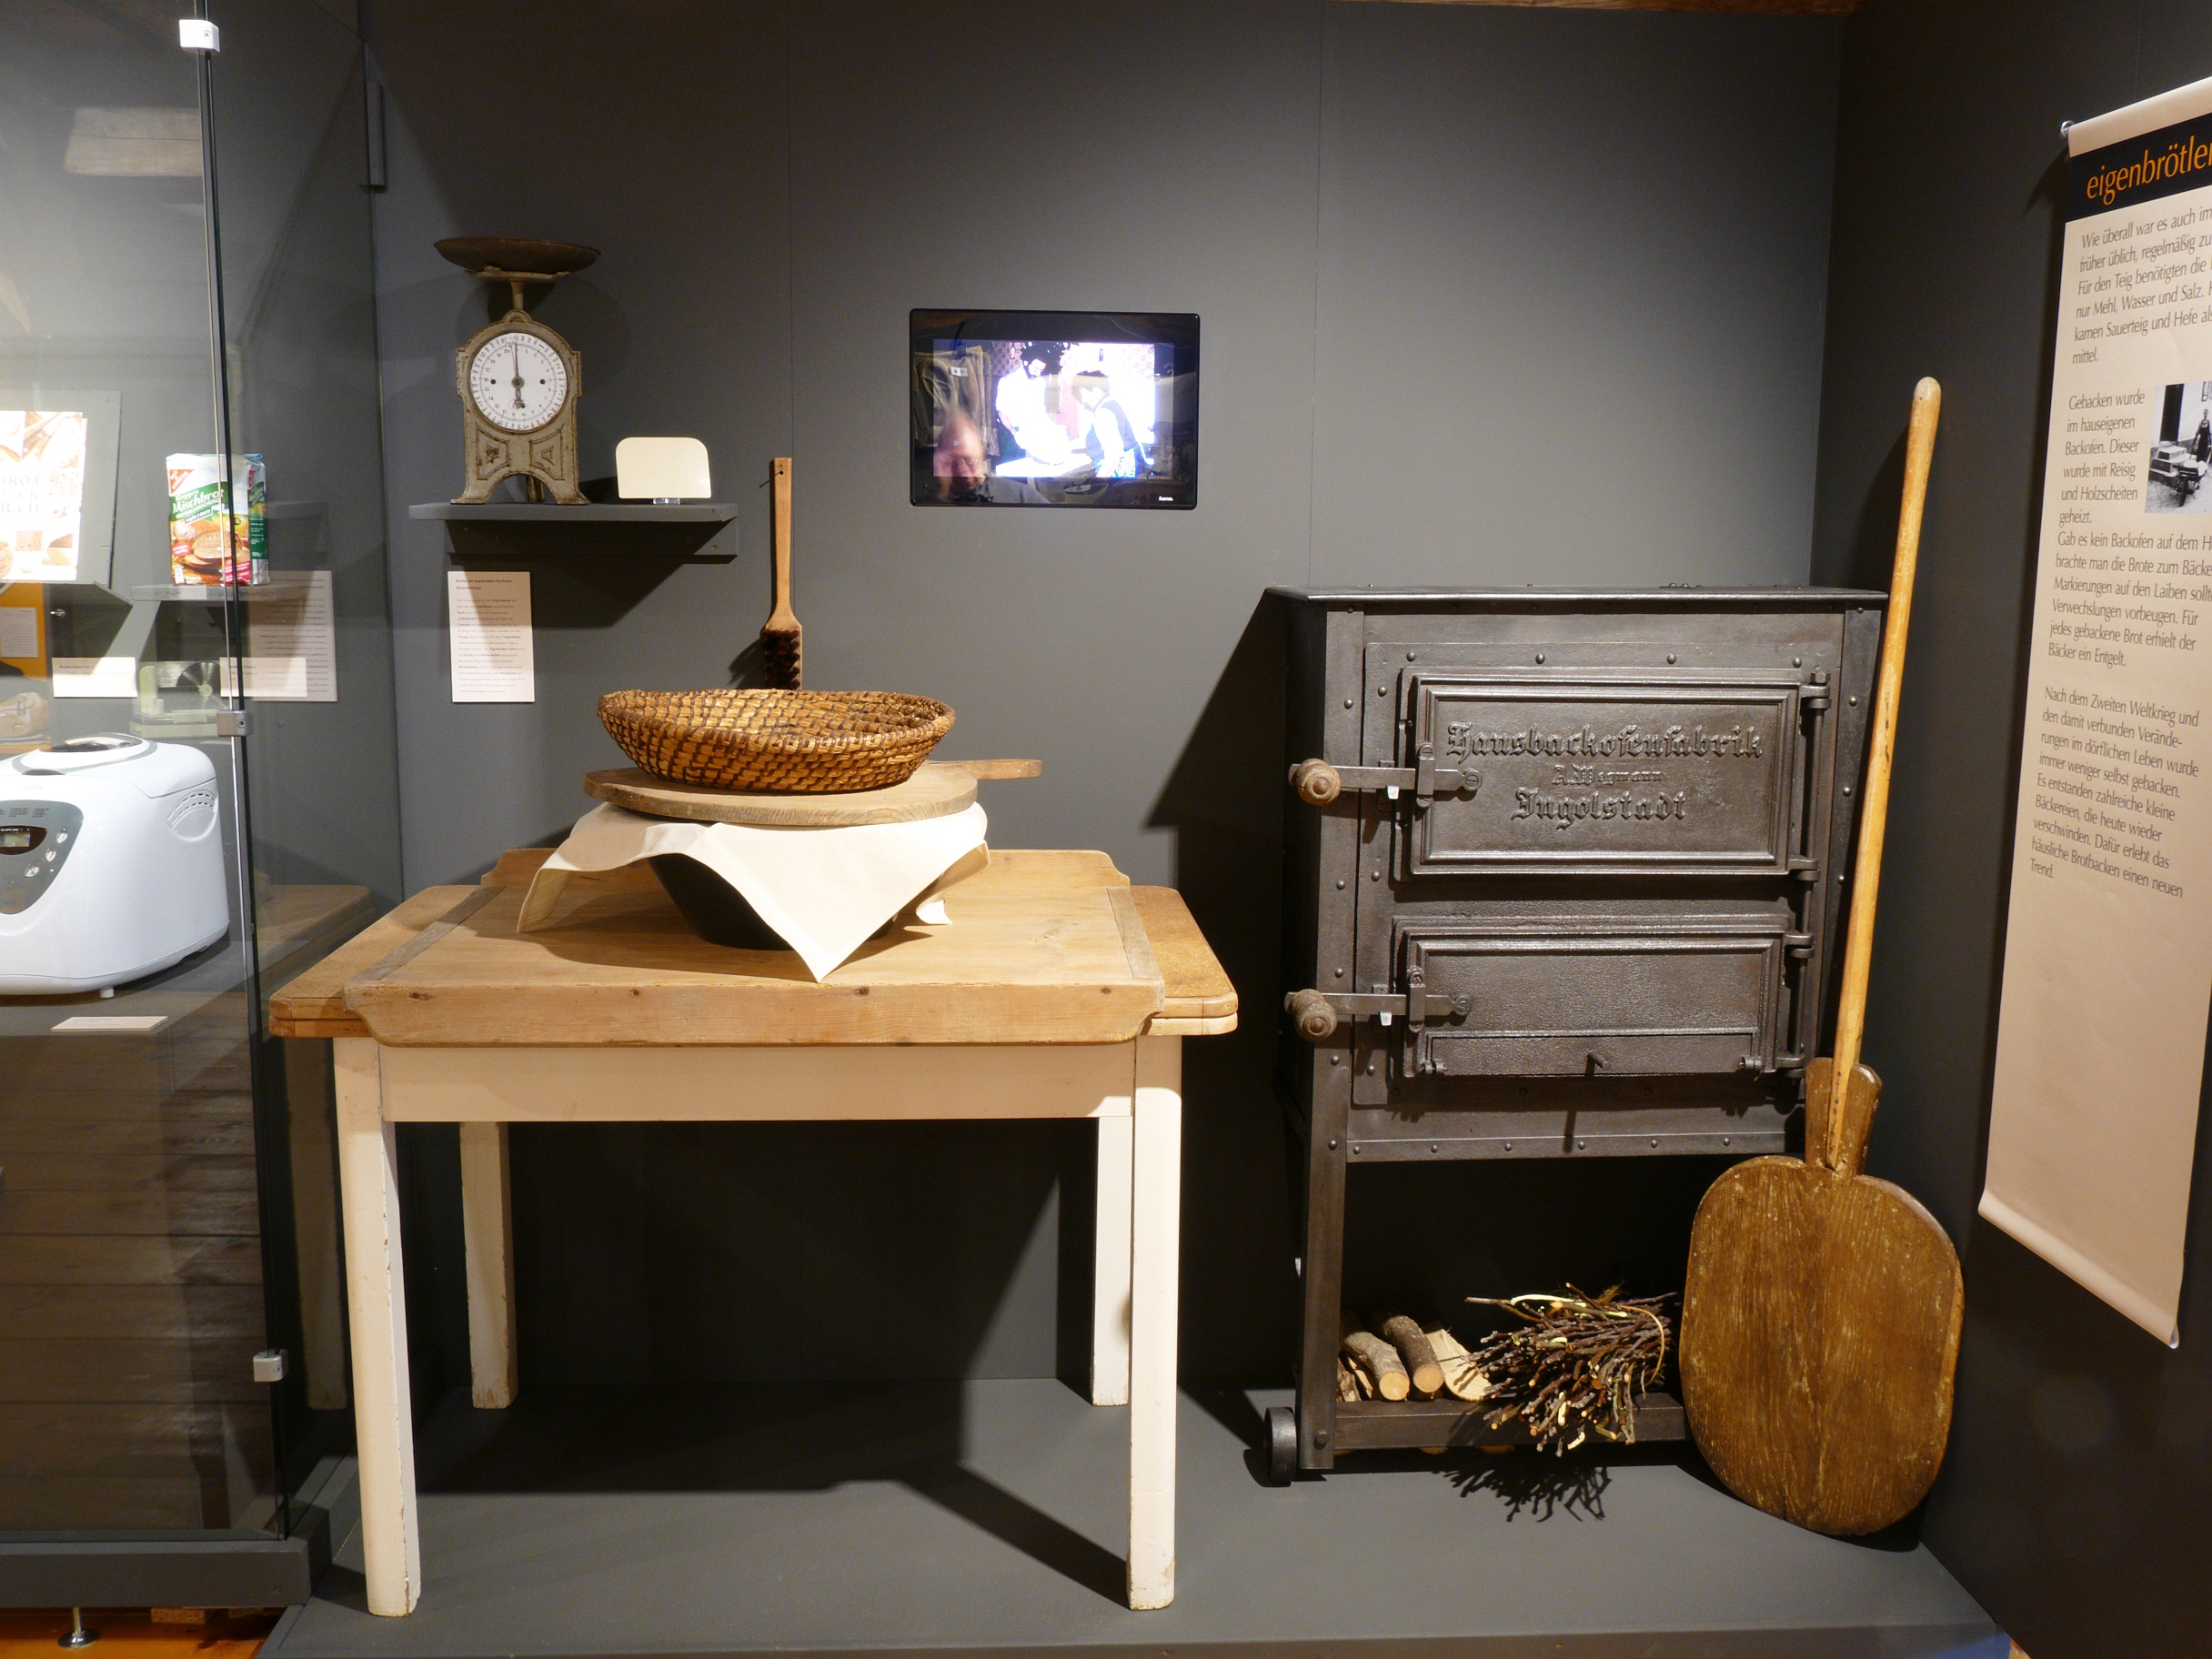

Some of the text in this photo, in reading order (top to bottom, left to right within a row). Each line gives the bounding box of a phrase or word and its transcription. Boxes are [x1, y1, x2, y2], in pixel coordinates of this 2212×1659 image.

[2082, 233, 2100, 248] Wie
[2103, 222, 2133, 244] überall
[2137, 222, 2154, 236] war
[2157, 218, 2167, 231] es
[2170, 207, 2196, 228] auch
[2080, 255, 2106, 272] früher
[2108, 246, 2137, 266] üblich,
[2141, 234, 2196, 262] regelmäßig
[2078, 280, 2092, 296] Für
[2095, 276, 2111, 293] den
[2115, 272, 2133, 291] Teig
[2136, 264, 2187, 284] benötigten
[2190, 256, 2207, 275] die
[2076, 306, 2091, 318] nur
[2093, 297, 2117, 316] Mehl,
[2122, 295, 2156, 310] Wasser
[2159, 286, 2178, 304] und
[2181, 282, 2204, 301] Salz.
[2074, 327, 2103, 342] kamen
[2106, 317, 2148, 337] Sauerteig
[2152, 311, 2170, 330] und
[2174, 307, 2197, 327] Hefe
[2072, 347, 2098, 364] mittel.
[2068, 388, 2145, 409] Gebacken wurde
[2066, 416, 2136, 435] im hauseigenen
[2066, 438, 2139, 455] Backofen. Dieser
[2063, 462, 2136, 481] wurde mit Reisig
[2061, 485, 2137, 500] und Holzscheiten
[2059, 508, 2092, 528] geheizt.
[2057, 531, 2076, 546] Gab
[2078, 535, 2087, 546] es
[2091, 531, 2108, 548] kein
[2112, 533, 2154, 548] Backofen
[2157, 533, 2174, 549] auf
[2176, 534, 2198, 550] dem
[2056, 553, 2086, 569] brachte
[2089, 558, 2108, 570] man
[2111, 556, 2126, 571] die
[2128, 558, 2154, 573] Brote
[2157, 562, 2178, 574] zum
[2054, 577, 2112, 598] Markierungen
[2116, 580, 2130, 595] auf
[2132, 580, 2150, 597] den
[2154, 583, 2187, 599] Laiben
[2053, 598, 2199, 628] Verwechslungen vorbeugen. Für
[2050, 620, 2196, 651] jedes gebackene Brot erhielt der
[2048, 642, 2127, 669] Bäcker ein Entgelt.
[2045, 687, 2199, 728] Nach dem Zweiten Weltkrieg und
[2043, 708, 2183, 748] den damit verbunden Verände-
[2041, 733, 2199, 777] rungen im dörflichen Leben wurde
[2039, 751, 2180, 799] immer weniger selbst gebacken.
[1511, 786, 1687, 831] Ingolstadt
[2037, 773, 2176, 820] Es entstanden zahlreiche kleine
[2036, 795, 2163, 842] Bäckereien, die heute wieder
[2034, 819, 2169, 870] verschwinden. Dafür erlebt das
[2030, 858, 2054, 879] Trend.
[2032, 836, 2183, 898] häusliche Brotbacken einen neuen
